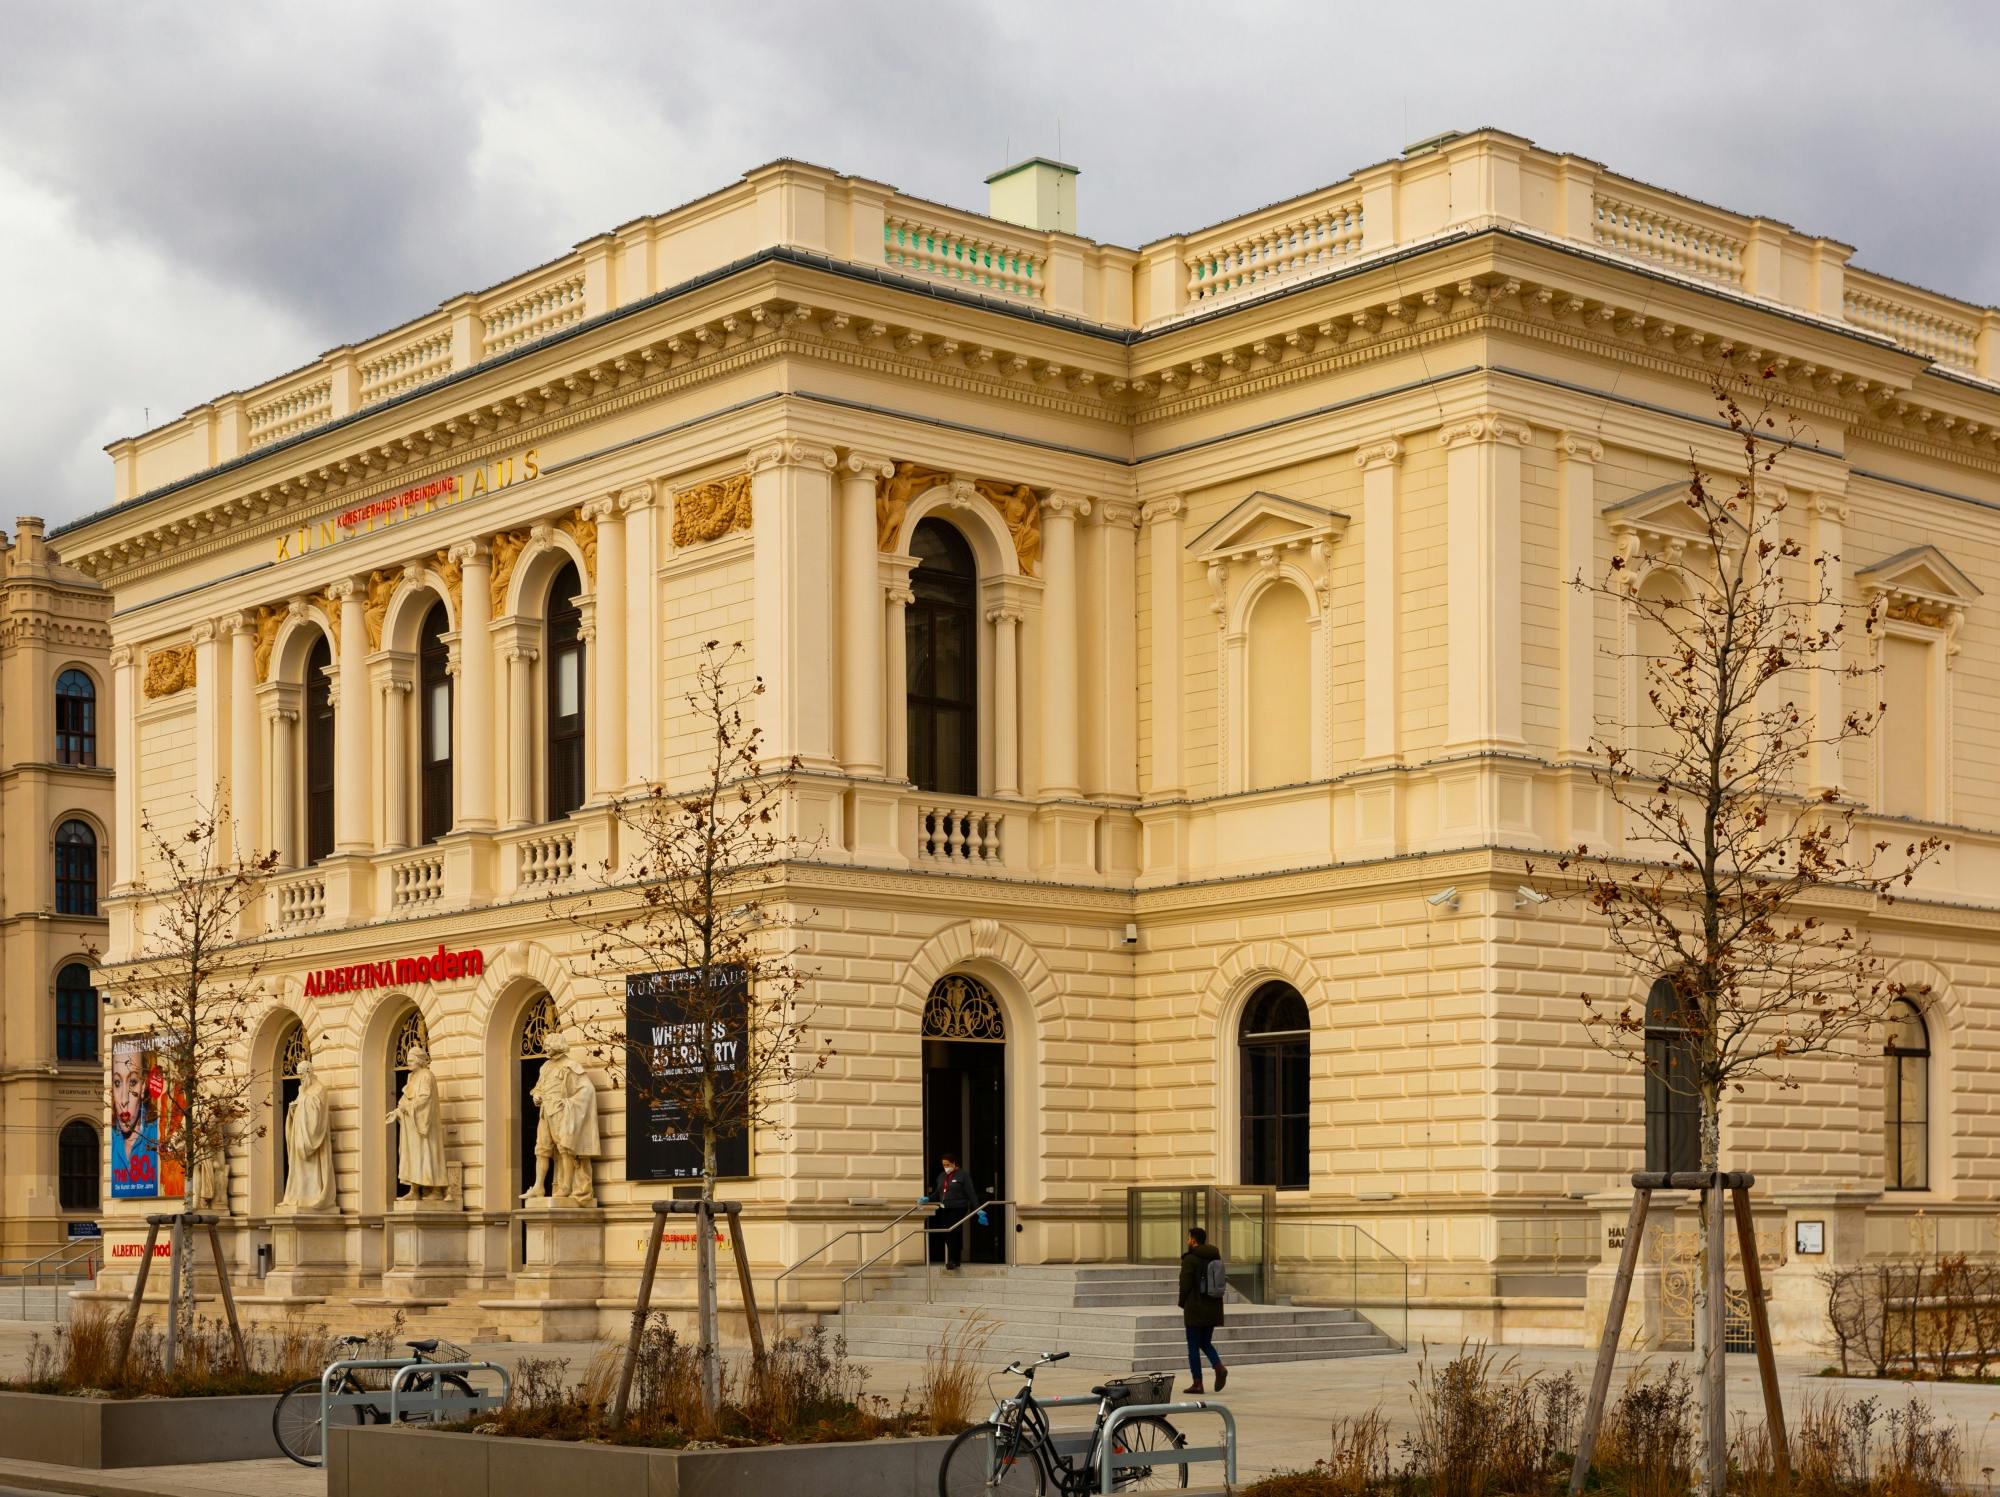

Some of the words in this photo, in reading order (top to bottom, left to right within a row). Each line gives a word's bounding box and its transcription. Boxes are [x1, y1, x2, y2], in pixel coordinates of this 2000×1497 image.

[336, 496, 397, 529] KÜNSTLERHAUS
[399, 476, 454, 507] VEREINIGUNG
[303, 959, 396, 997] ALBERTINA
[395, 944, 483, 985] modern
[113, 1168, 129, 1183] THE
[112, 1244, 147, 1257] ALBERTIN
